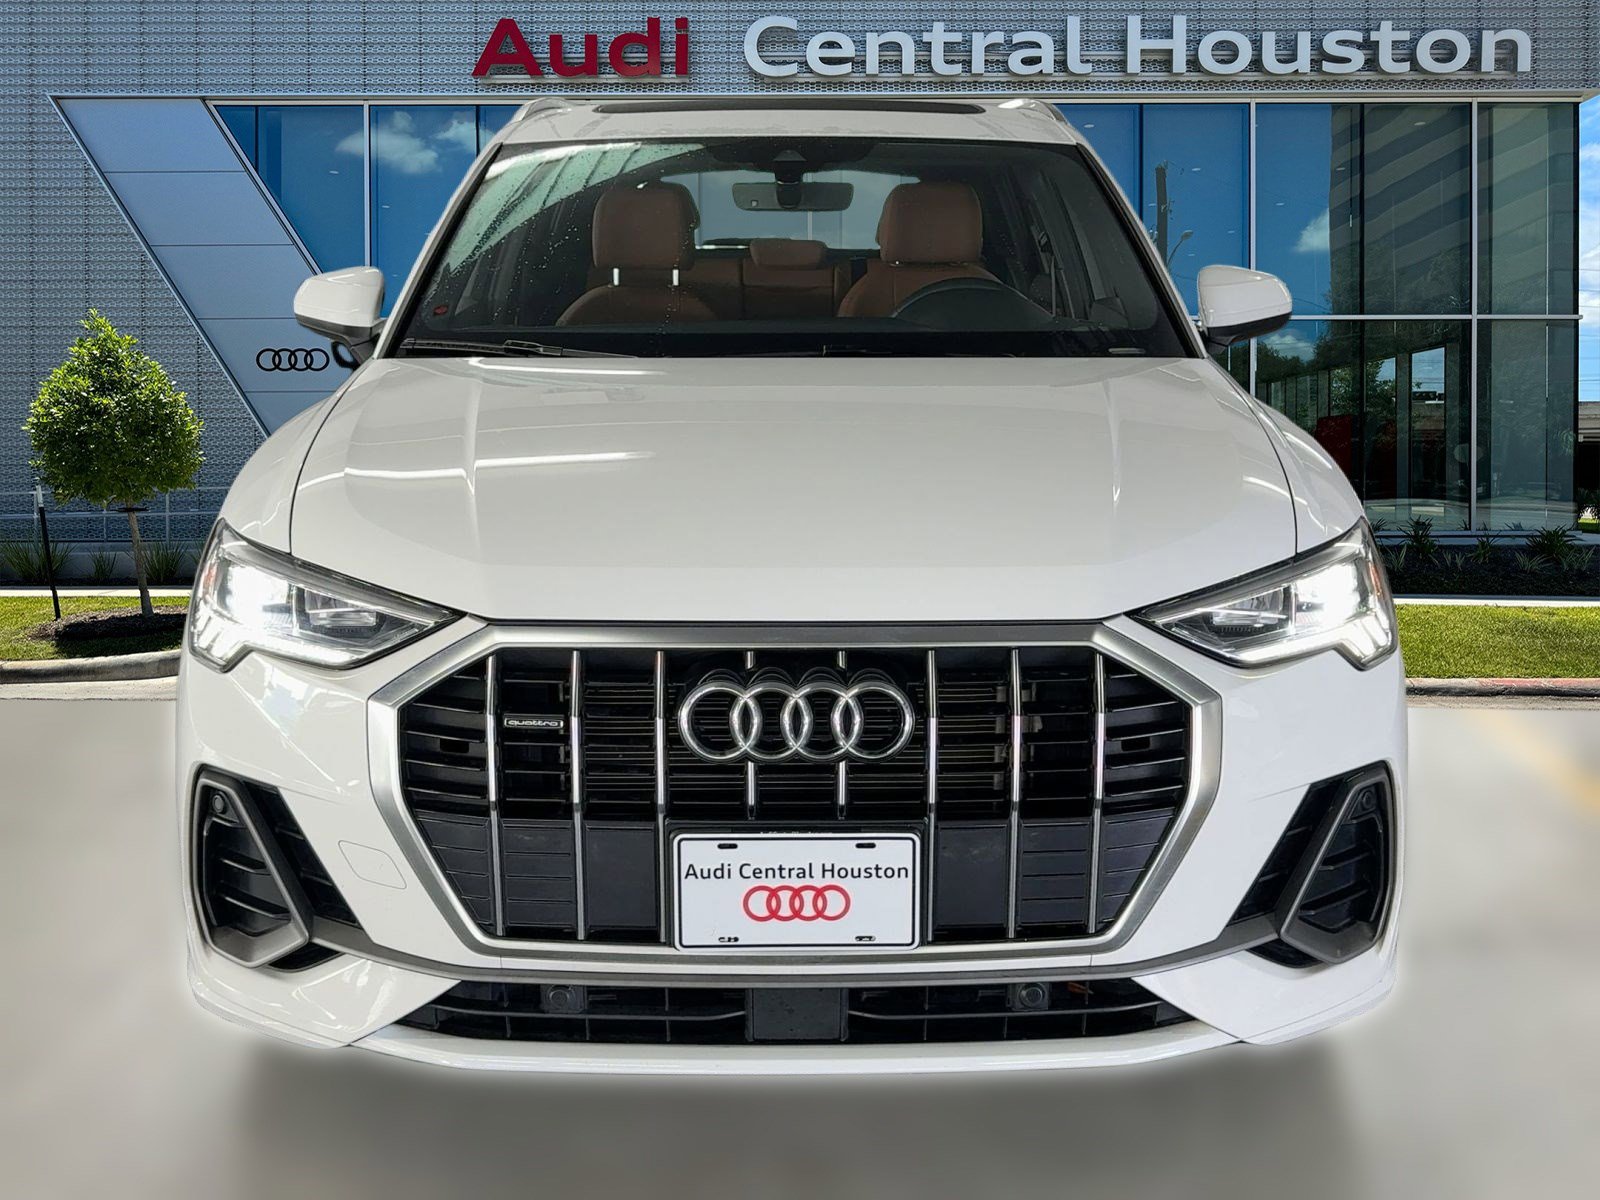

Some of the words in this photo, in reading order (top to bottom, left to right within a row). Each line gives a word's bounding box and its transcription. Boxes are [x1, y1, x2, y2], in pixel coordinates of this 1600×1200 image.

[471, 16, 690, 79] Audi
[743, 15, 1093, 77] Central
[1126, 14, 1533, 76] Houston
[507, 719, 559, 728] quattro
[684, 862, 732, 880] Audi
[738, 862, 815, 880] Central
[821, 862, 909, 880] Houston
